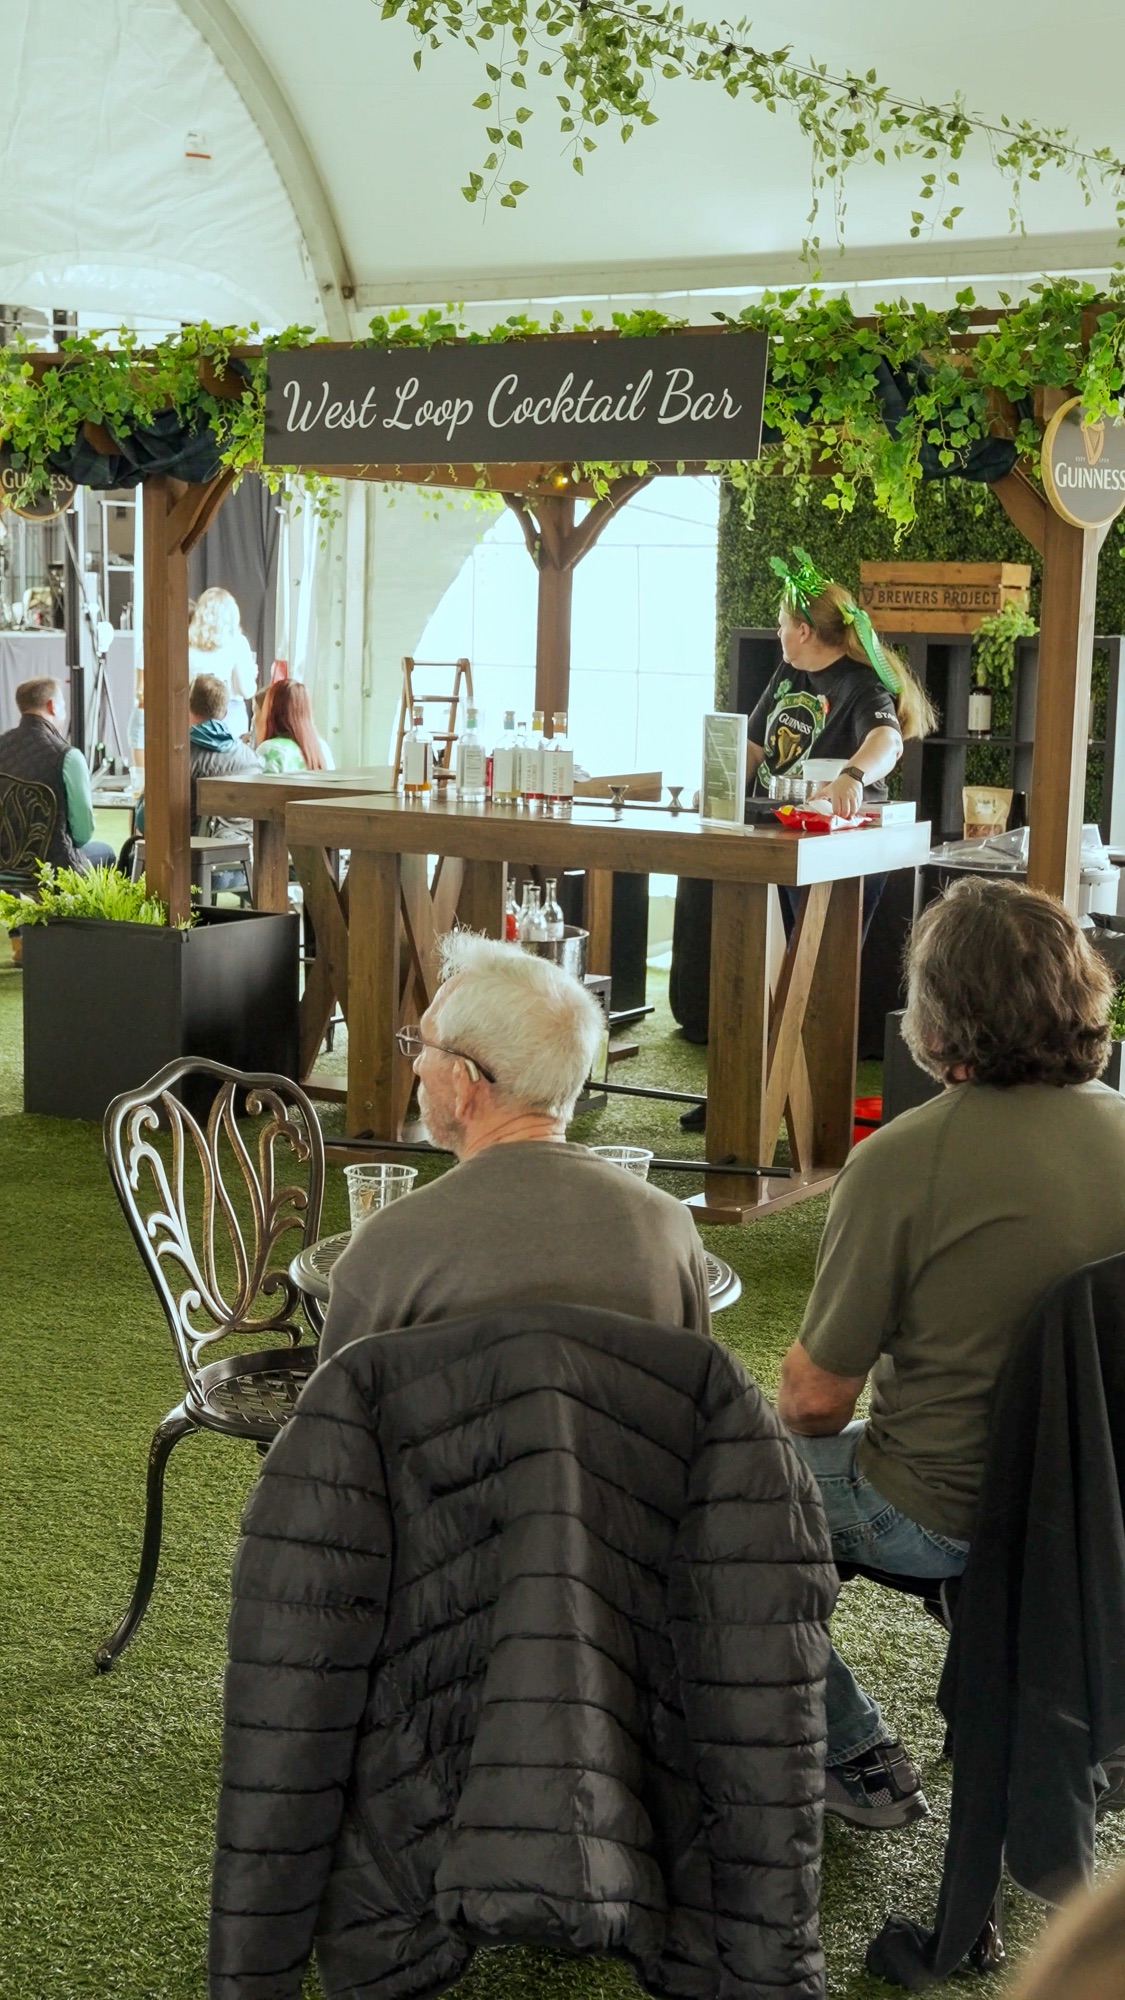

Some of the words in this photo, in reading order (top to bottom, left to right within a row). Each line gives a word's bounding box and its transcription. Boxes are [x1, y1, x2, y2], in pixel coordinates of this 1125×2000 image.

[283, 379, 376, 433] West
[382, 376, 474, 442] Loop
[487, 368, 654, 429] Cocktail
[656, 367, 743, 425] Bar
[2, 468, 74, 492] GUESS
[1054, 462, 1125, 491] GUINNESS
[877, 590, 938, 605] BREWERS
[943, 590, 999, 606] PROJECT
